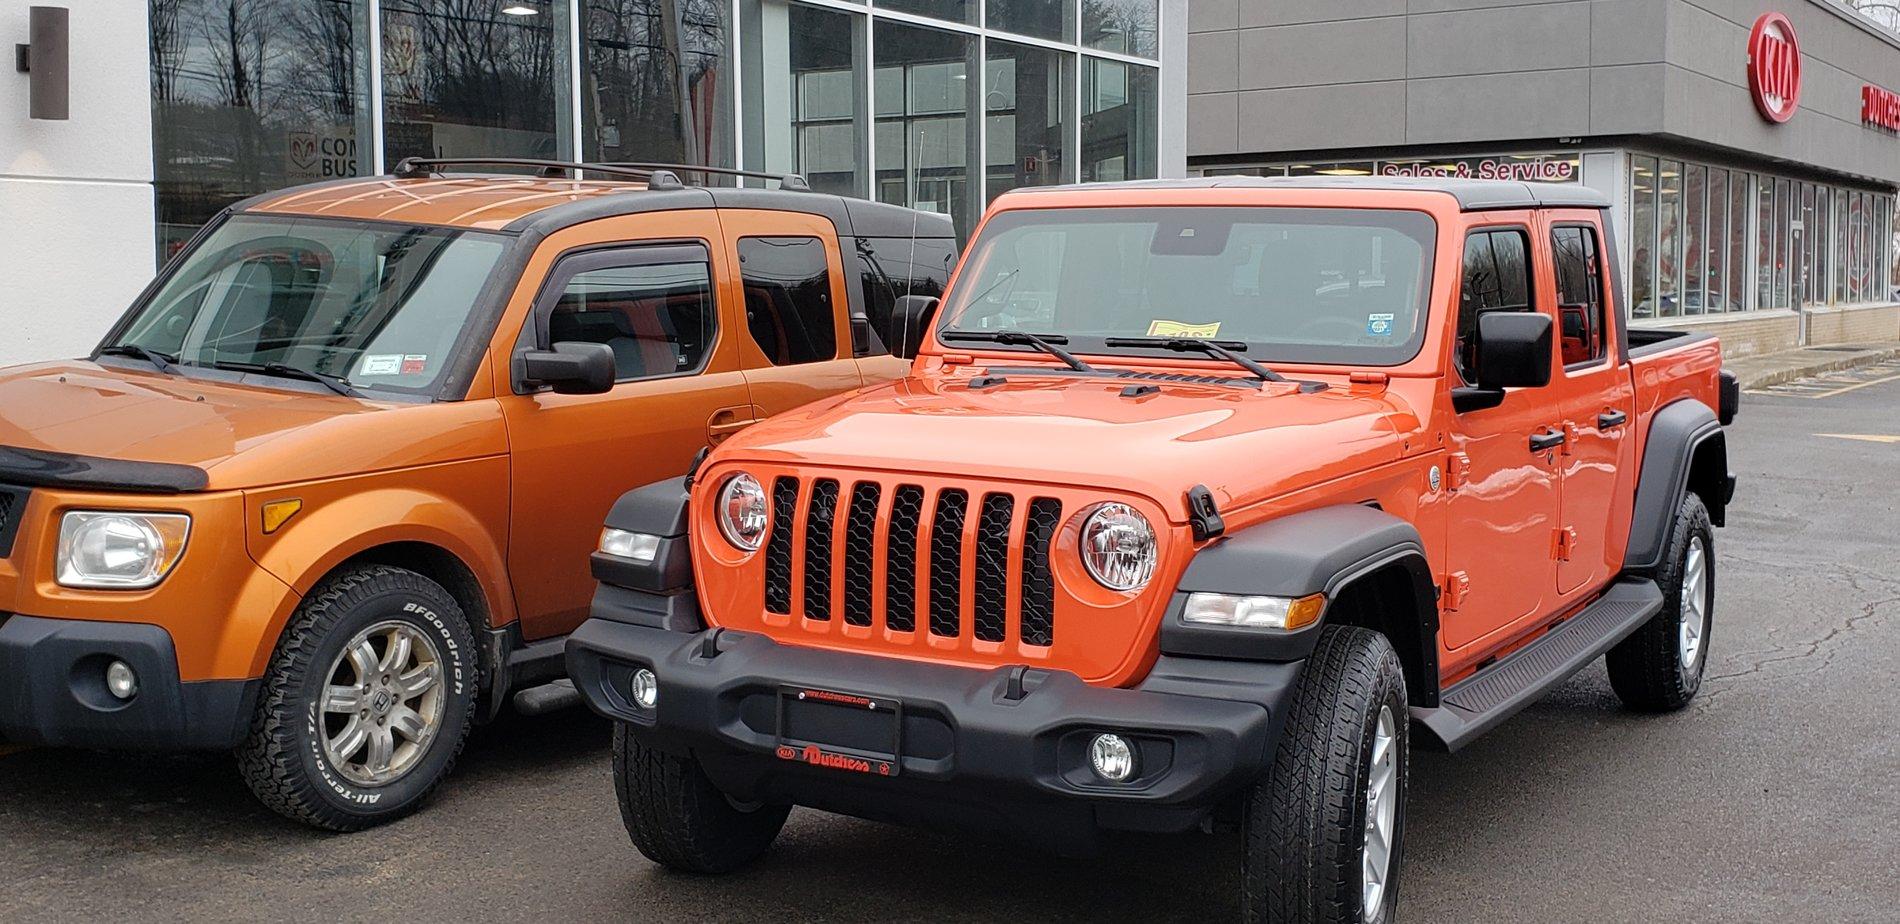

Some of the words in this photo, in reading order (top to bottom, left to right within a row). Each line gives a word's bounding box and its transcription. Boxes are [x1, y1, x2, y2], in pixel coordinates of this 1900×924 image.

[1763, 34, 1794, 101] KIA
[322, 158, 356, 177] BUS
[1456, 161, 1473, 179] &
[1479, 157, 1572, 181] Service
[403, 602, 463, 695] BFGoodrich
[308, 701, 316, 735] T/A
[311, 740, 382, 804] All-Terrain
[803, 745, 870, 772] Dutchess
